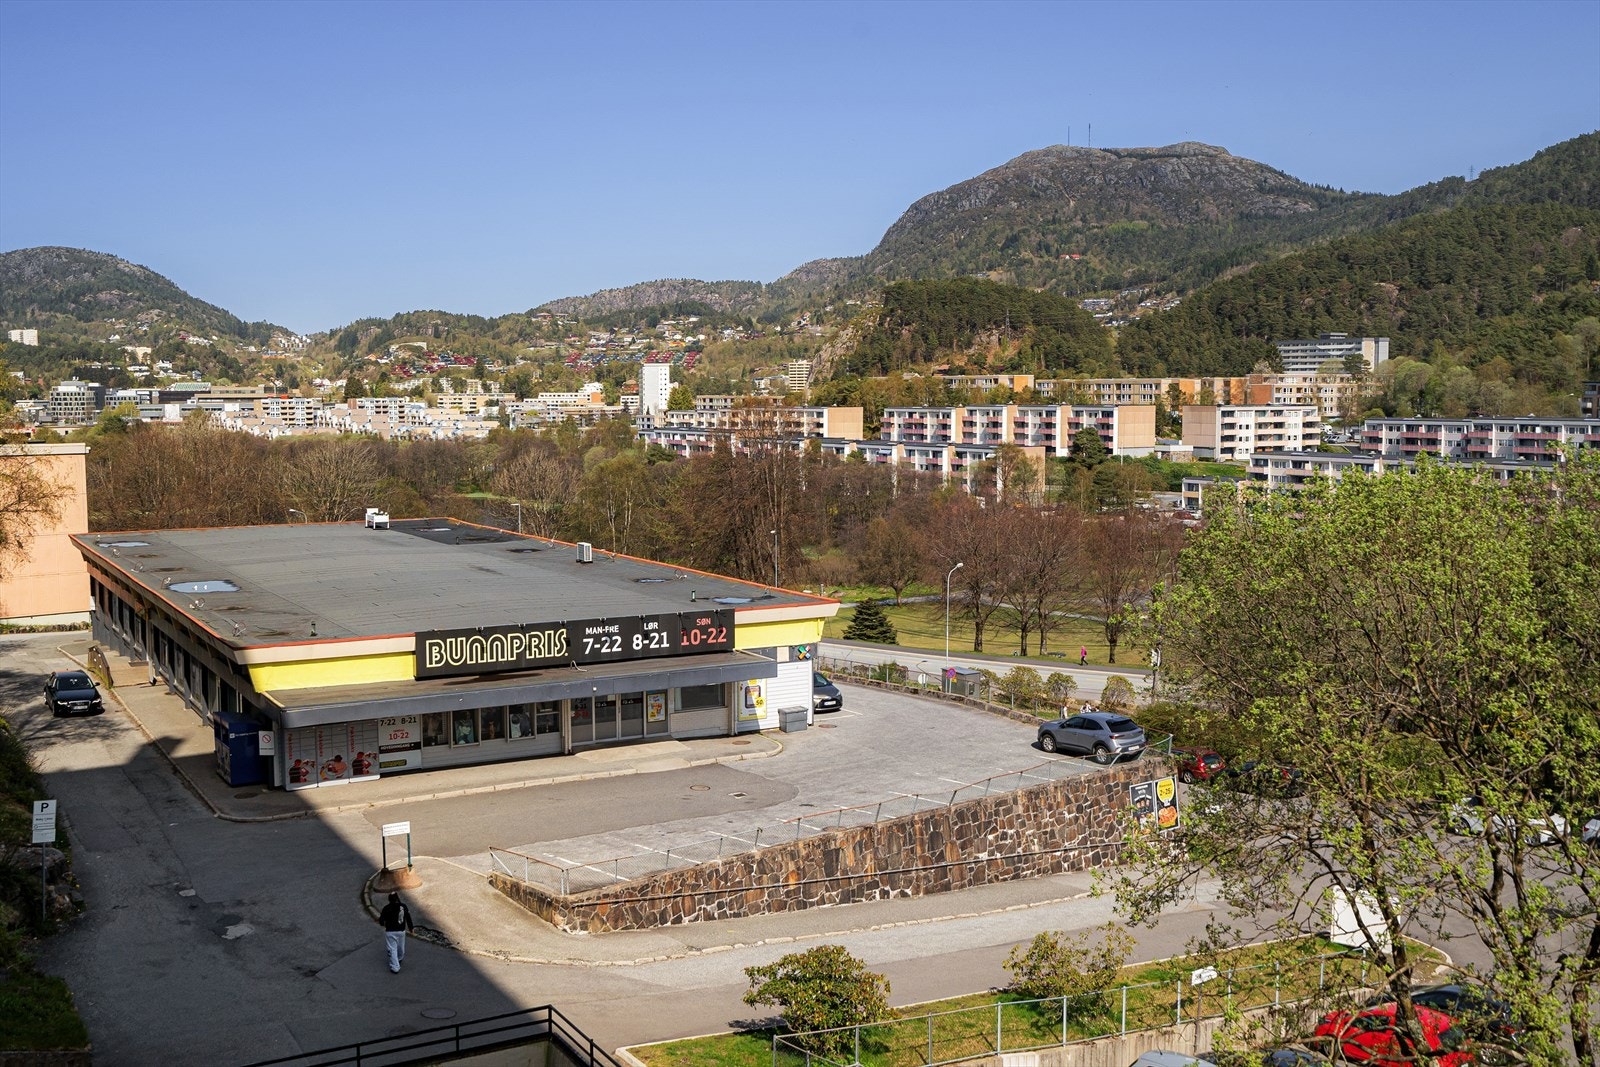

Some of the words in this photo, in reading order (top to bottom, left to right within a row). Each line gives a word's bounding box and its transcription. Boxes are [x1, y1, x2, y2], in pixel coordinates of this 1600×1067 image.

[585, 625, 620, 635] MAN-FRE
[643, 622, 659, 631] LØR
[696, 618, 711, 626] SØN
[582, 636, 622, 655] 7-22
[632, 632, 670, 650] 8-21
[680, 627, 727, 646] 10-22
[401, 716, 417, 725] 8-21
[41, 803, 49, 812] P
